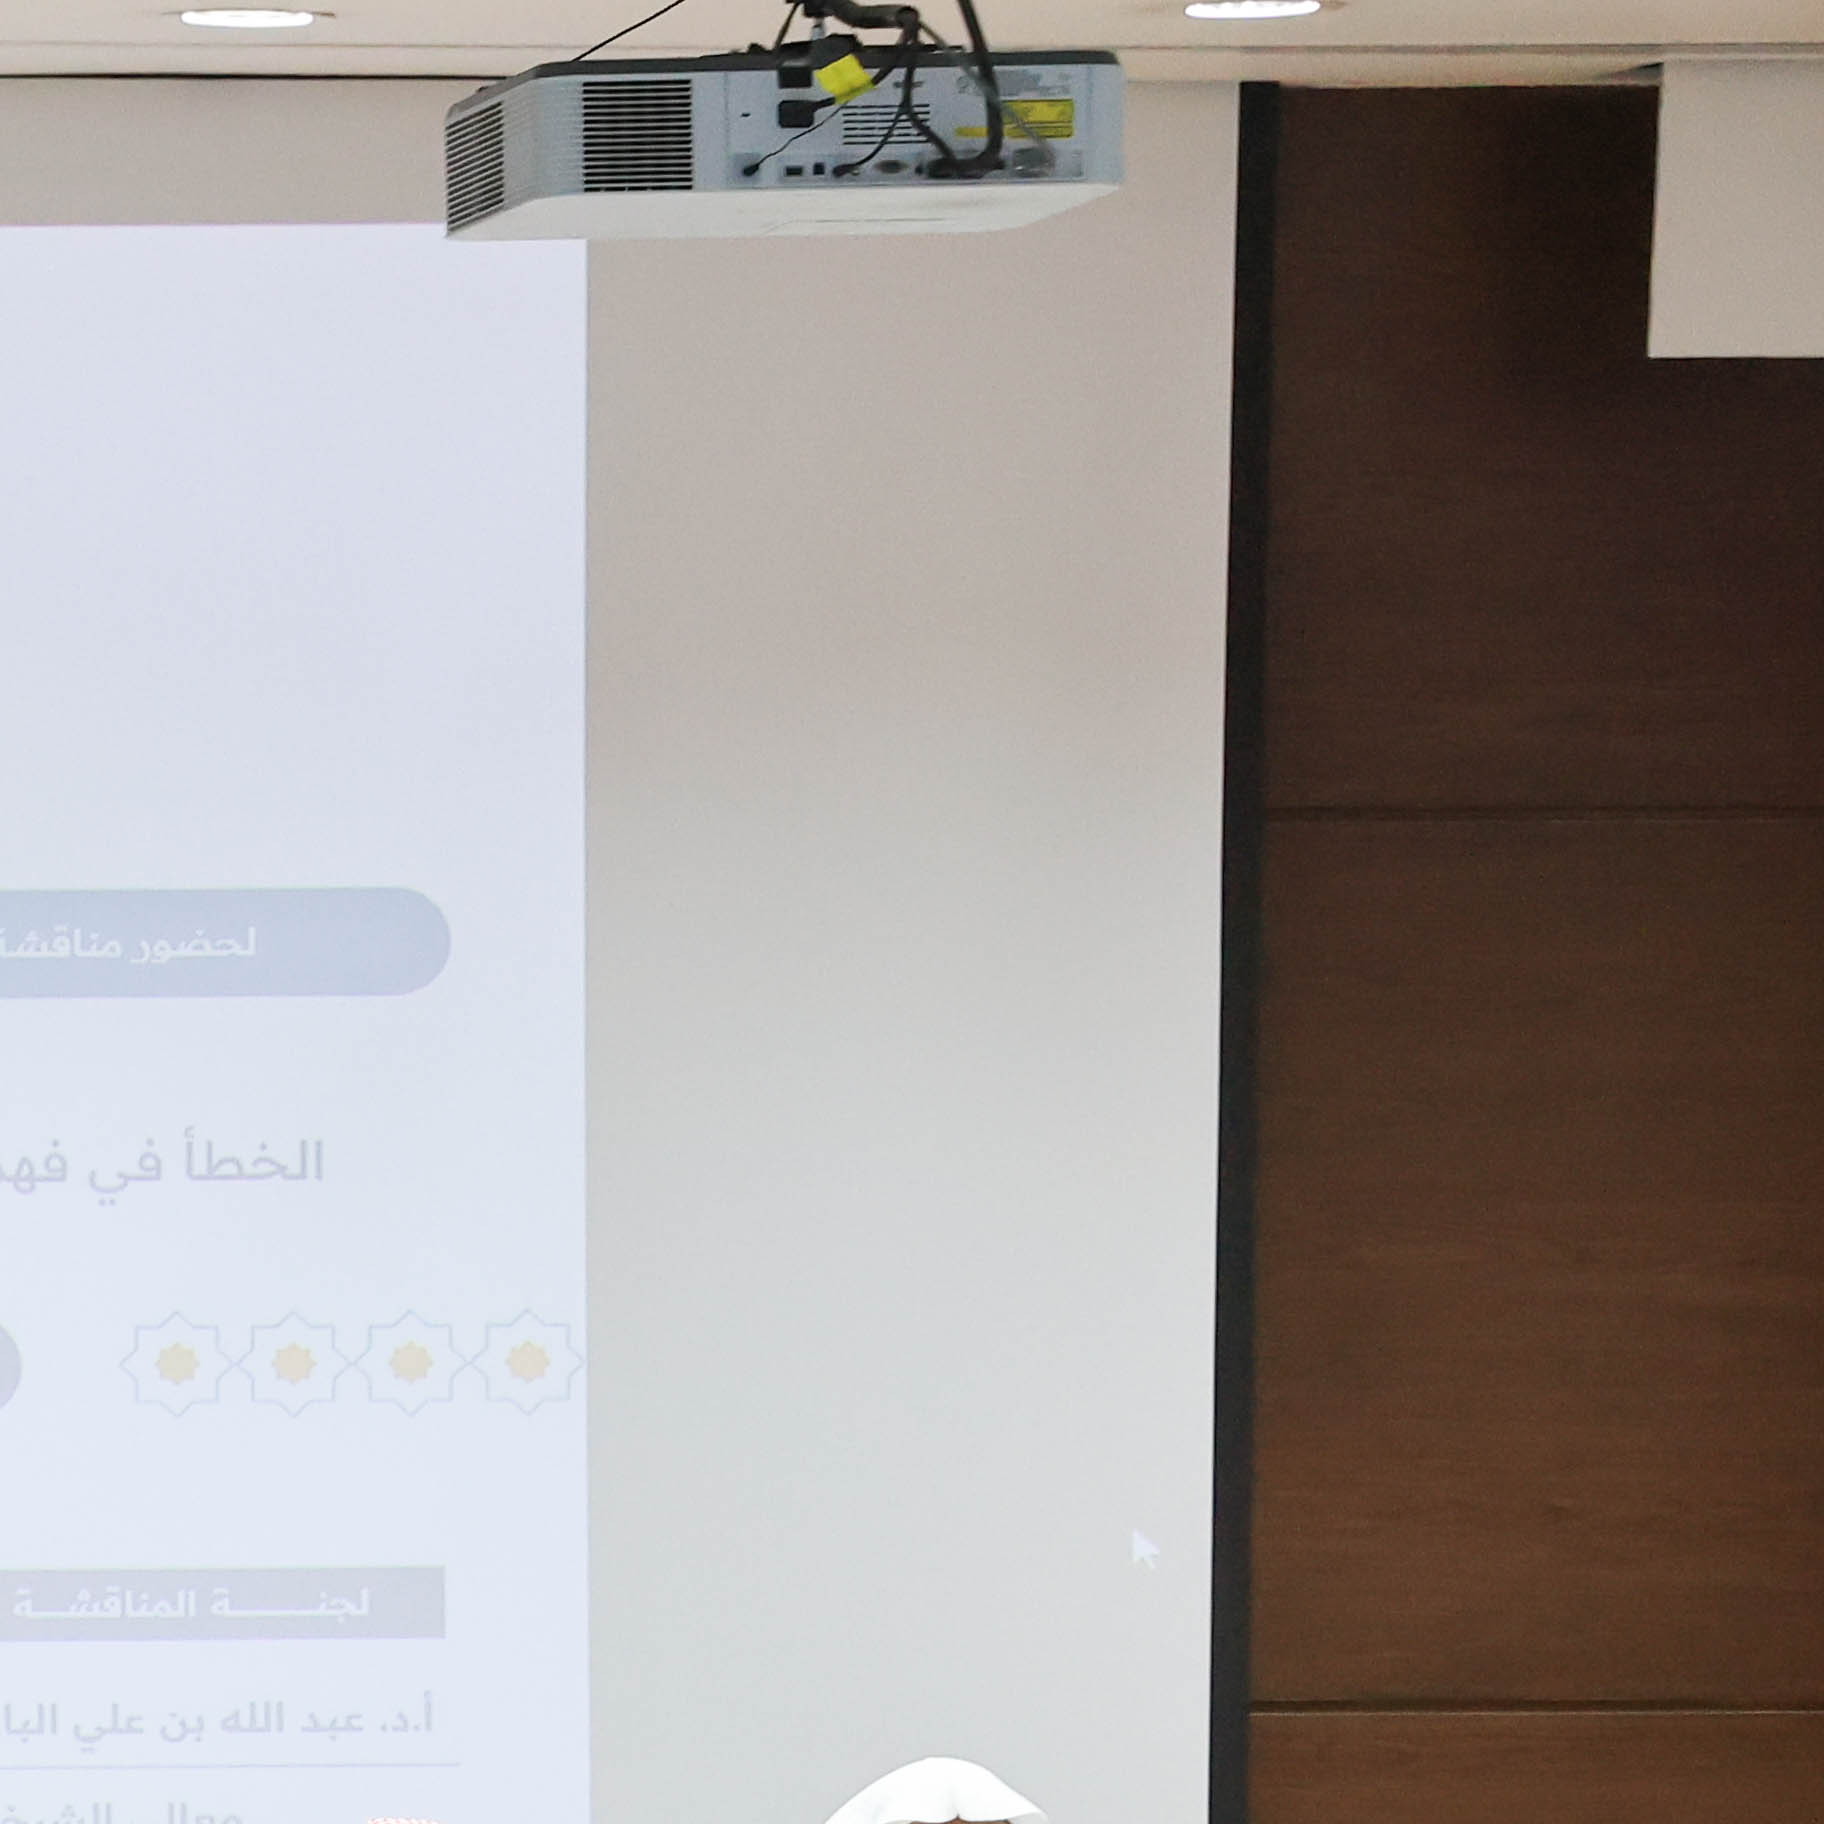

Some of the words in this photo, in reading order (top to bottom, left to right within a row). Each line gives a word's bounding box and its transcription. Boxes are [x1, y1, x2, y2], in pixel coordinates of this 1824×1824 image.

[130, 925, 257, 964] لحضور
[88, 1137, 163, 1207] في
[183, 1125, 324, 1182] الخطأ
[72, 1701, 145, 1754] علي
[159, 1712, 206, 1743] بن
[220, 1700, 285, 1734] الله
[300, 1712, 364, 1742] عبد
